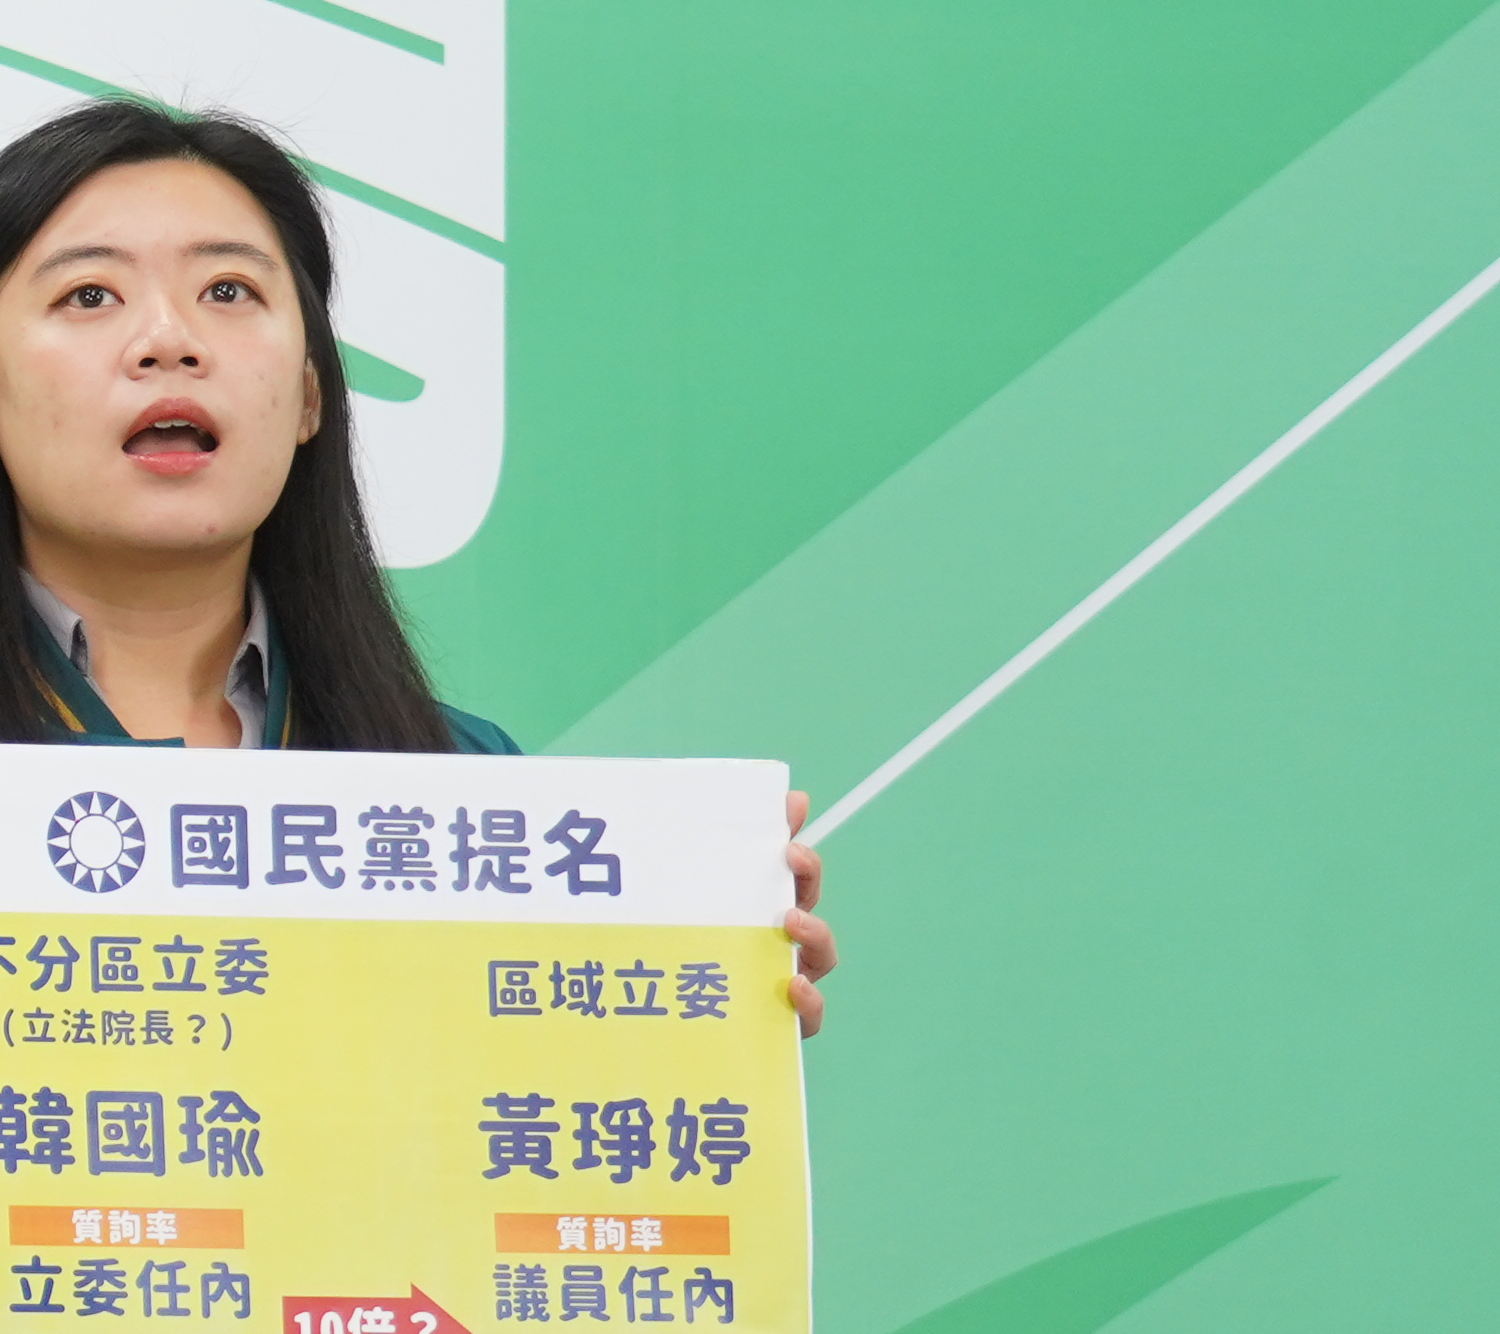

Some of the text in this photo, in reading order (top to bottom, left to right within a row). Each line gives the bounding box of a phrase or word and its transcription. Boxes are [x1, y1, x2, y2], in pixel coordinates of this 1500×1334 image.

[169, 803, 622, 897] 國民黨提名
[487, 959, 731, 1020] 區域立委
[478, 1092, 752, 1186] 黃琤婷
[70, 1208, 179, 1246] 質詢率
[556, 1216, 663, 1252] 質詢率
[8, 1255, 252, 1320] 立委任內
[493, 1264, 735, 1324] 議員任內
